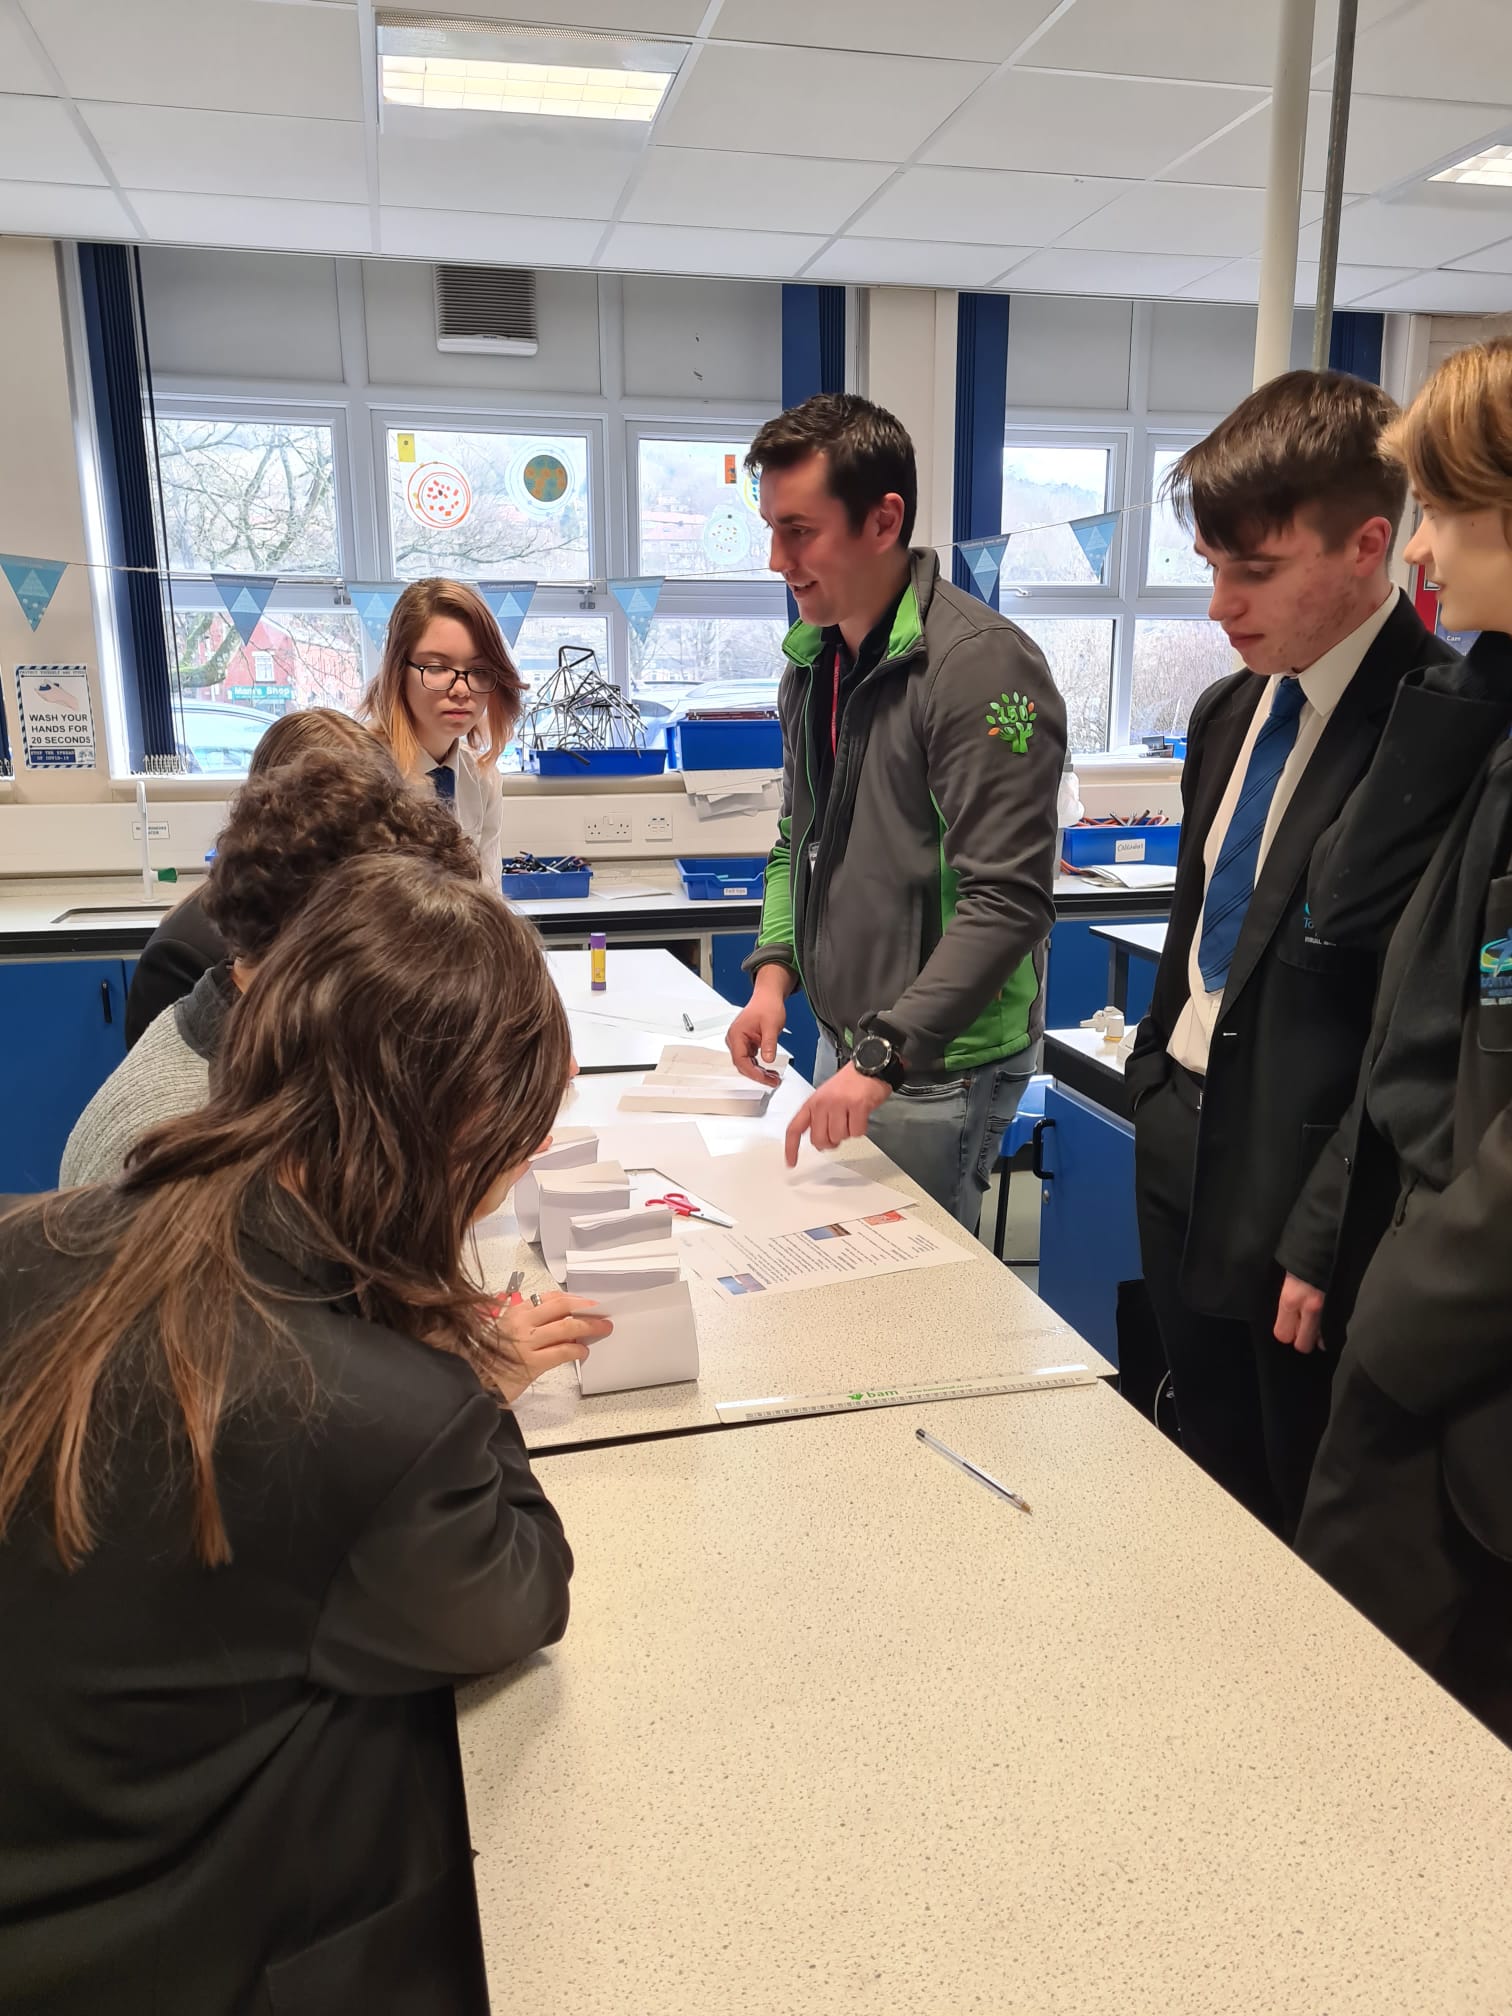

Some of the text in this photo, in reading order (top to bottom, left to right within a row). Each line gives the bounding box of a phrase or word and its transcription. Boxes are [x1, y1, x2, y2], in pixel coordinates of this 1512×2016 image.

[267, 686, 290, 696] Shop
[29, 714, 88, 722] WASH YOUR
[31, 725, 88, 733] HANDS FOR
[31, 736, 91, 744] 20 SECONDS
[866, 1390, 899, 1398] bam
